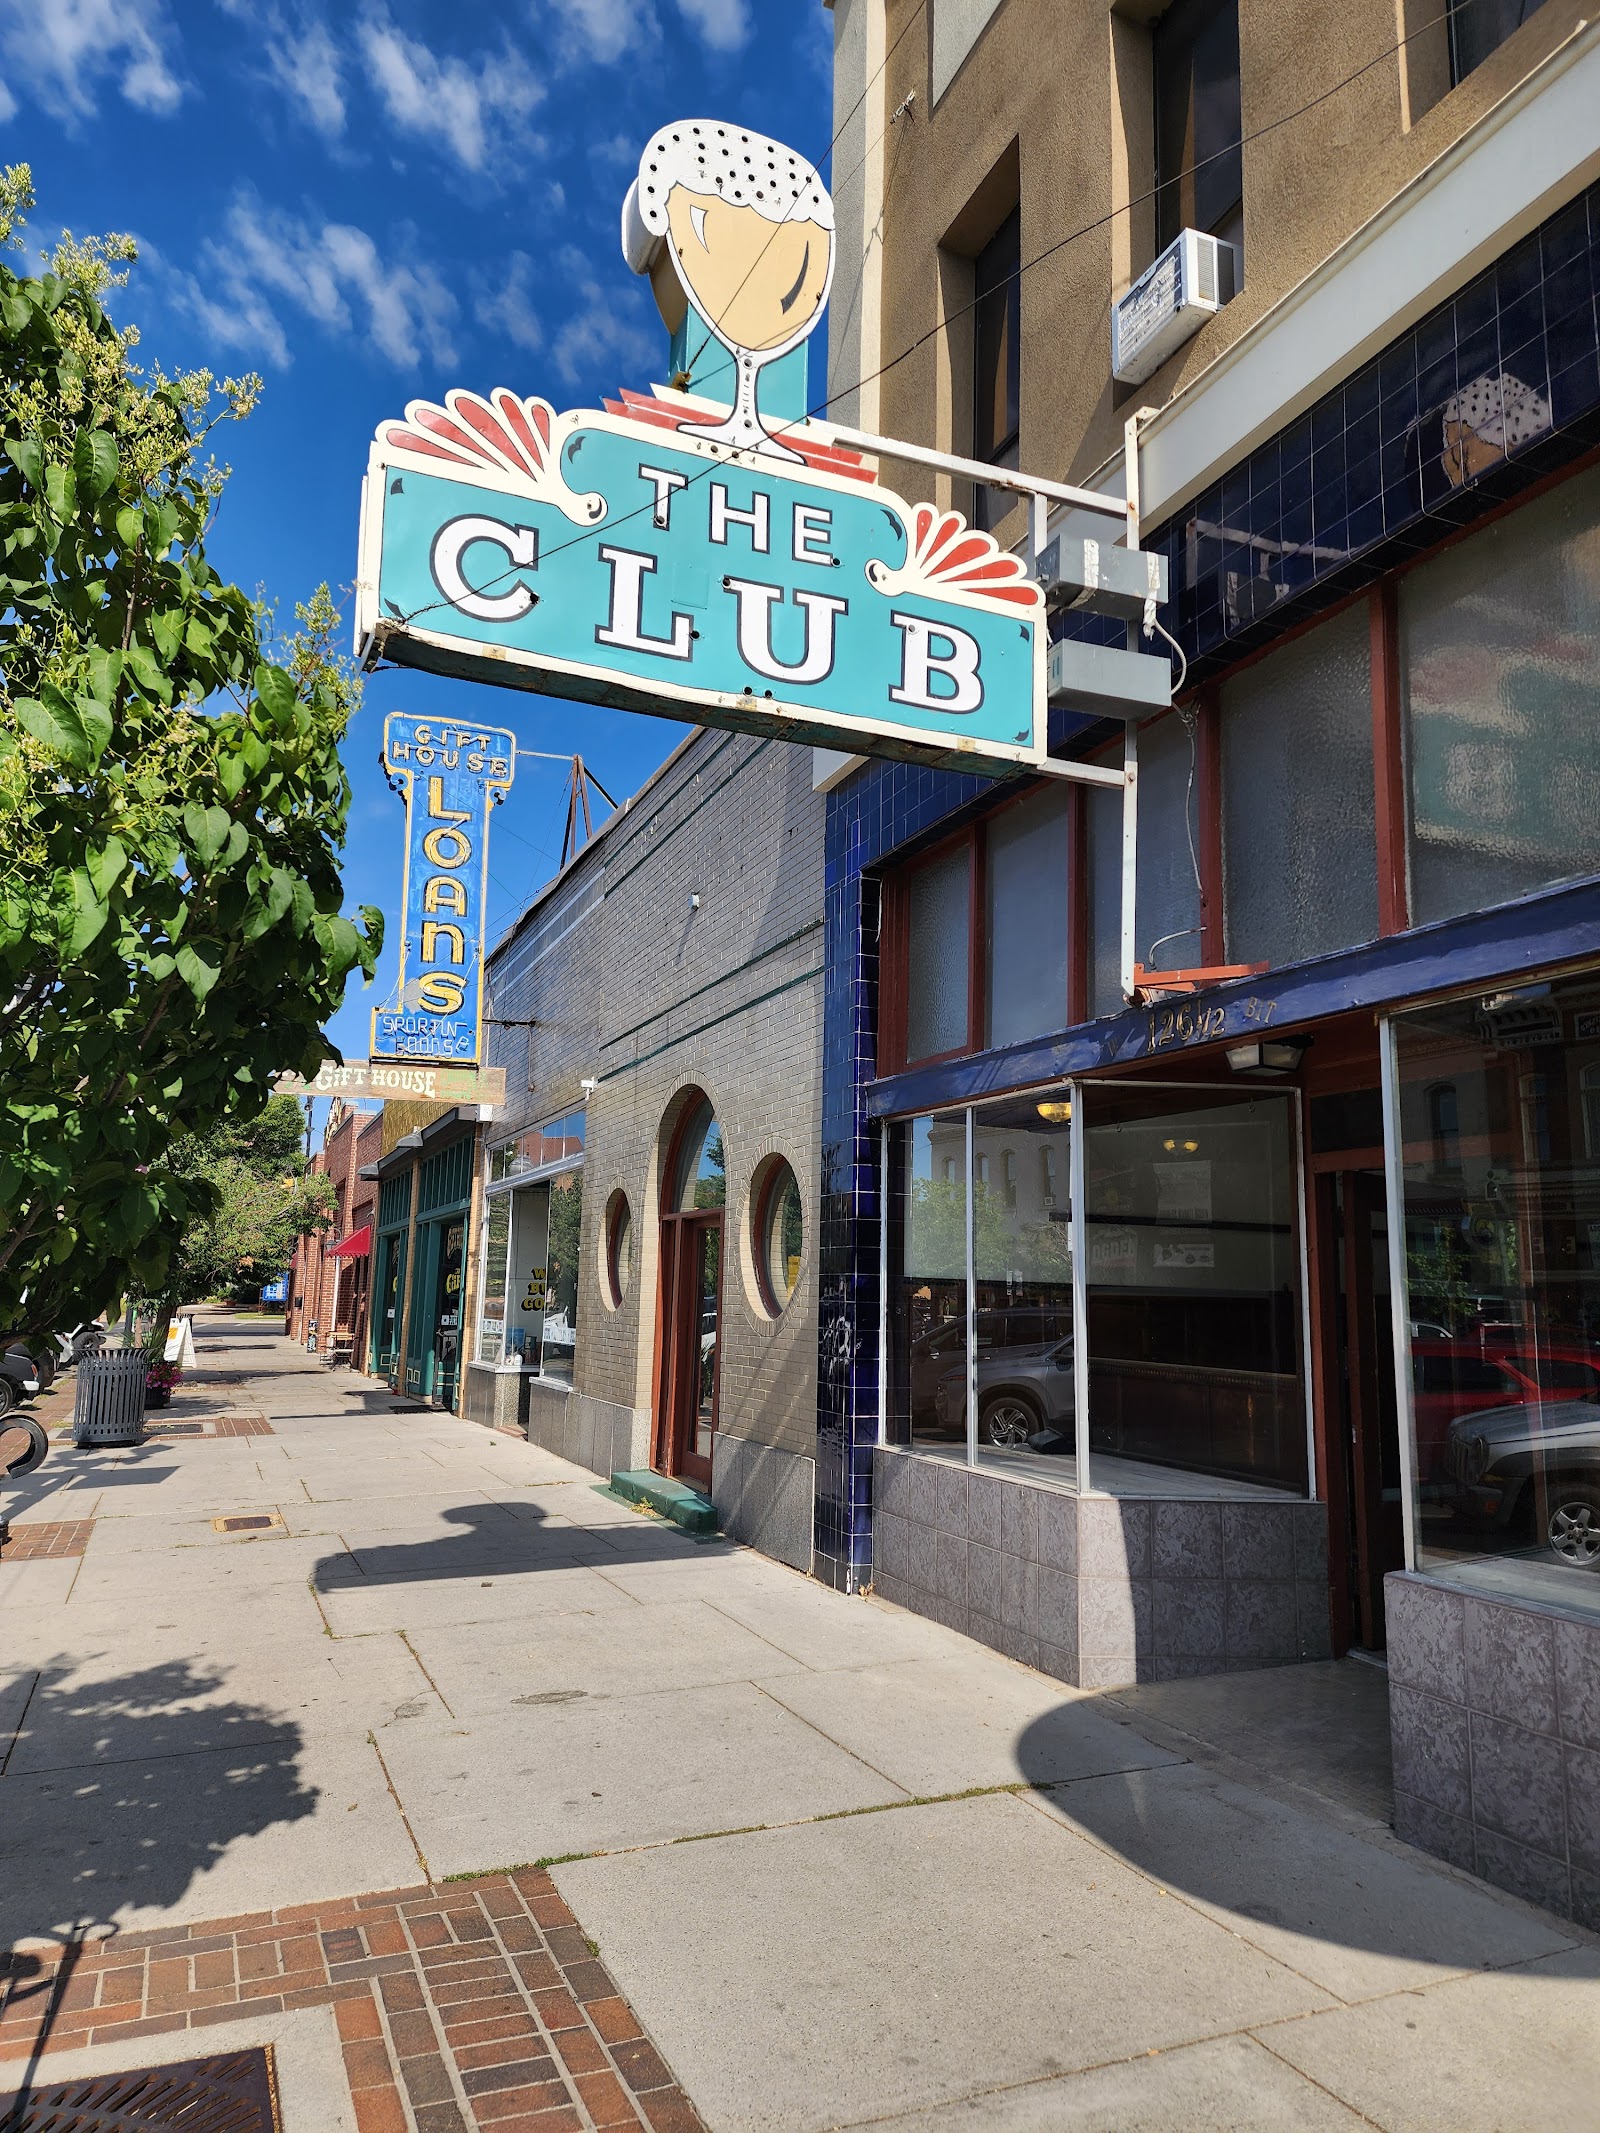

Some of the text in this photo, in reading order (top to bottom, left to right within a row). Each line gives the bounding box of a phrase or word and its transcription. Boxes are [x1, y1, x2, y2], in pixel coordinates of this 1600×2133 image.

[638, 463, 836, 568] THE
[429, 513, 985, 716] CLUB
[415, 725, 491, 752] GIFT
[393, 741, 509, 778] HOUSE
[372, 1069, 437, 1099] HOUSE
